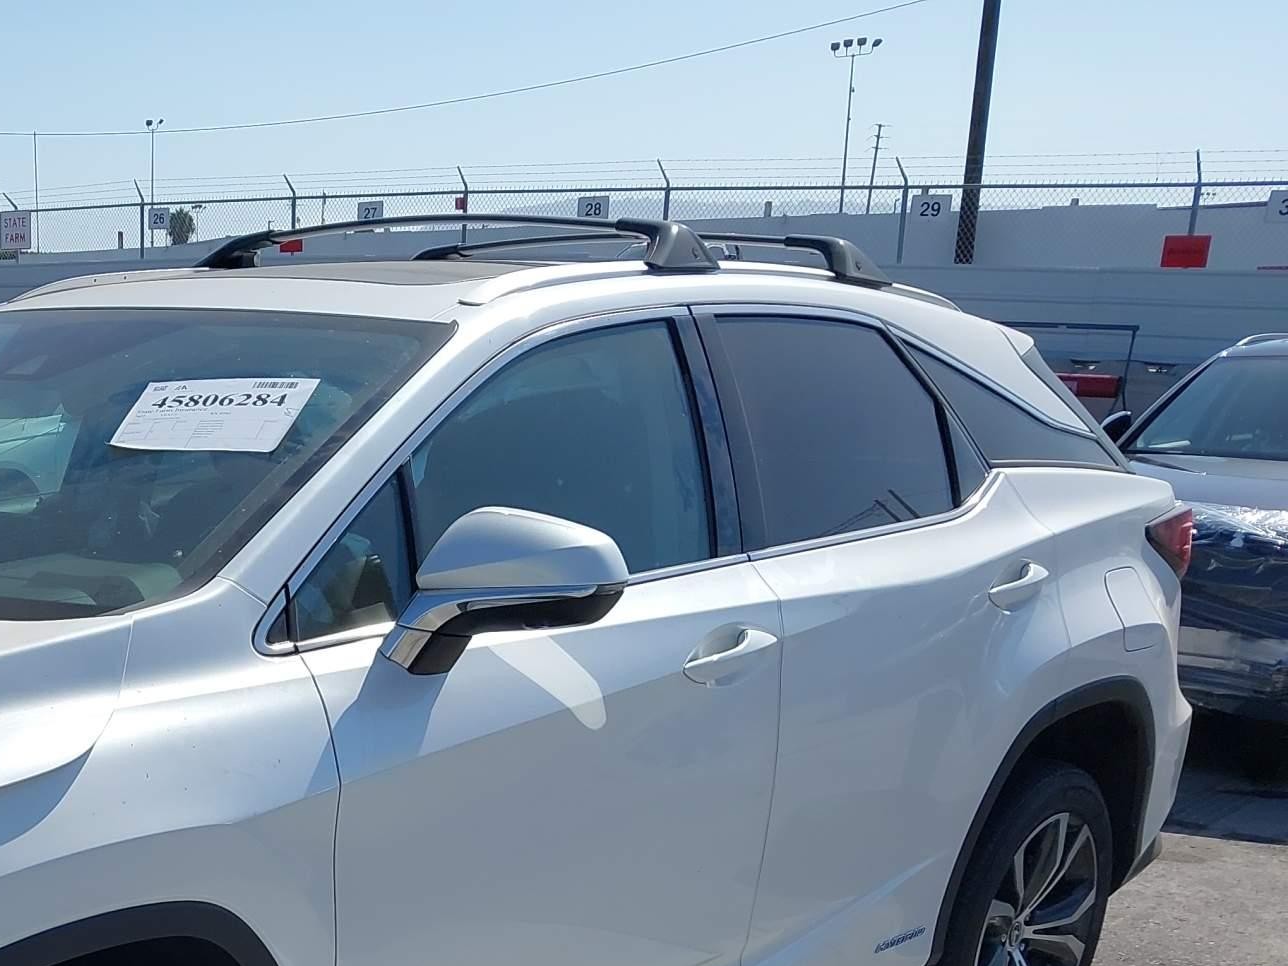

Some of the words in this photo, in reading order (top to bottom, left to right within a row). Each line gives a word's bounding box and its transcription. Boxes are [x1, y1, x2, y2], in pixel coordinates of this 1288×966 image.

[364, 207, 377, 219] 27
[585, 203, 601, 217] 28
[919, 202, 941, 217] 29
[1278, 198, 1288, 216] 3
[4, 217, 27, 229] STATE
[153, 213, 165, 225] 26
[5, 233, 26, 244] FARM
[151, 393, 288, 409] 45806284
